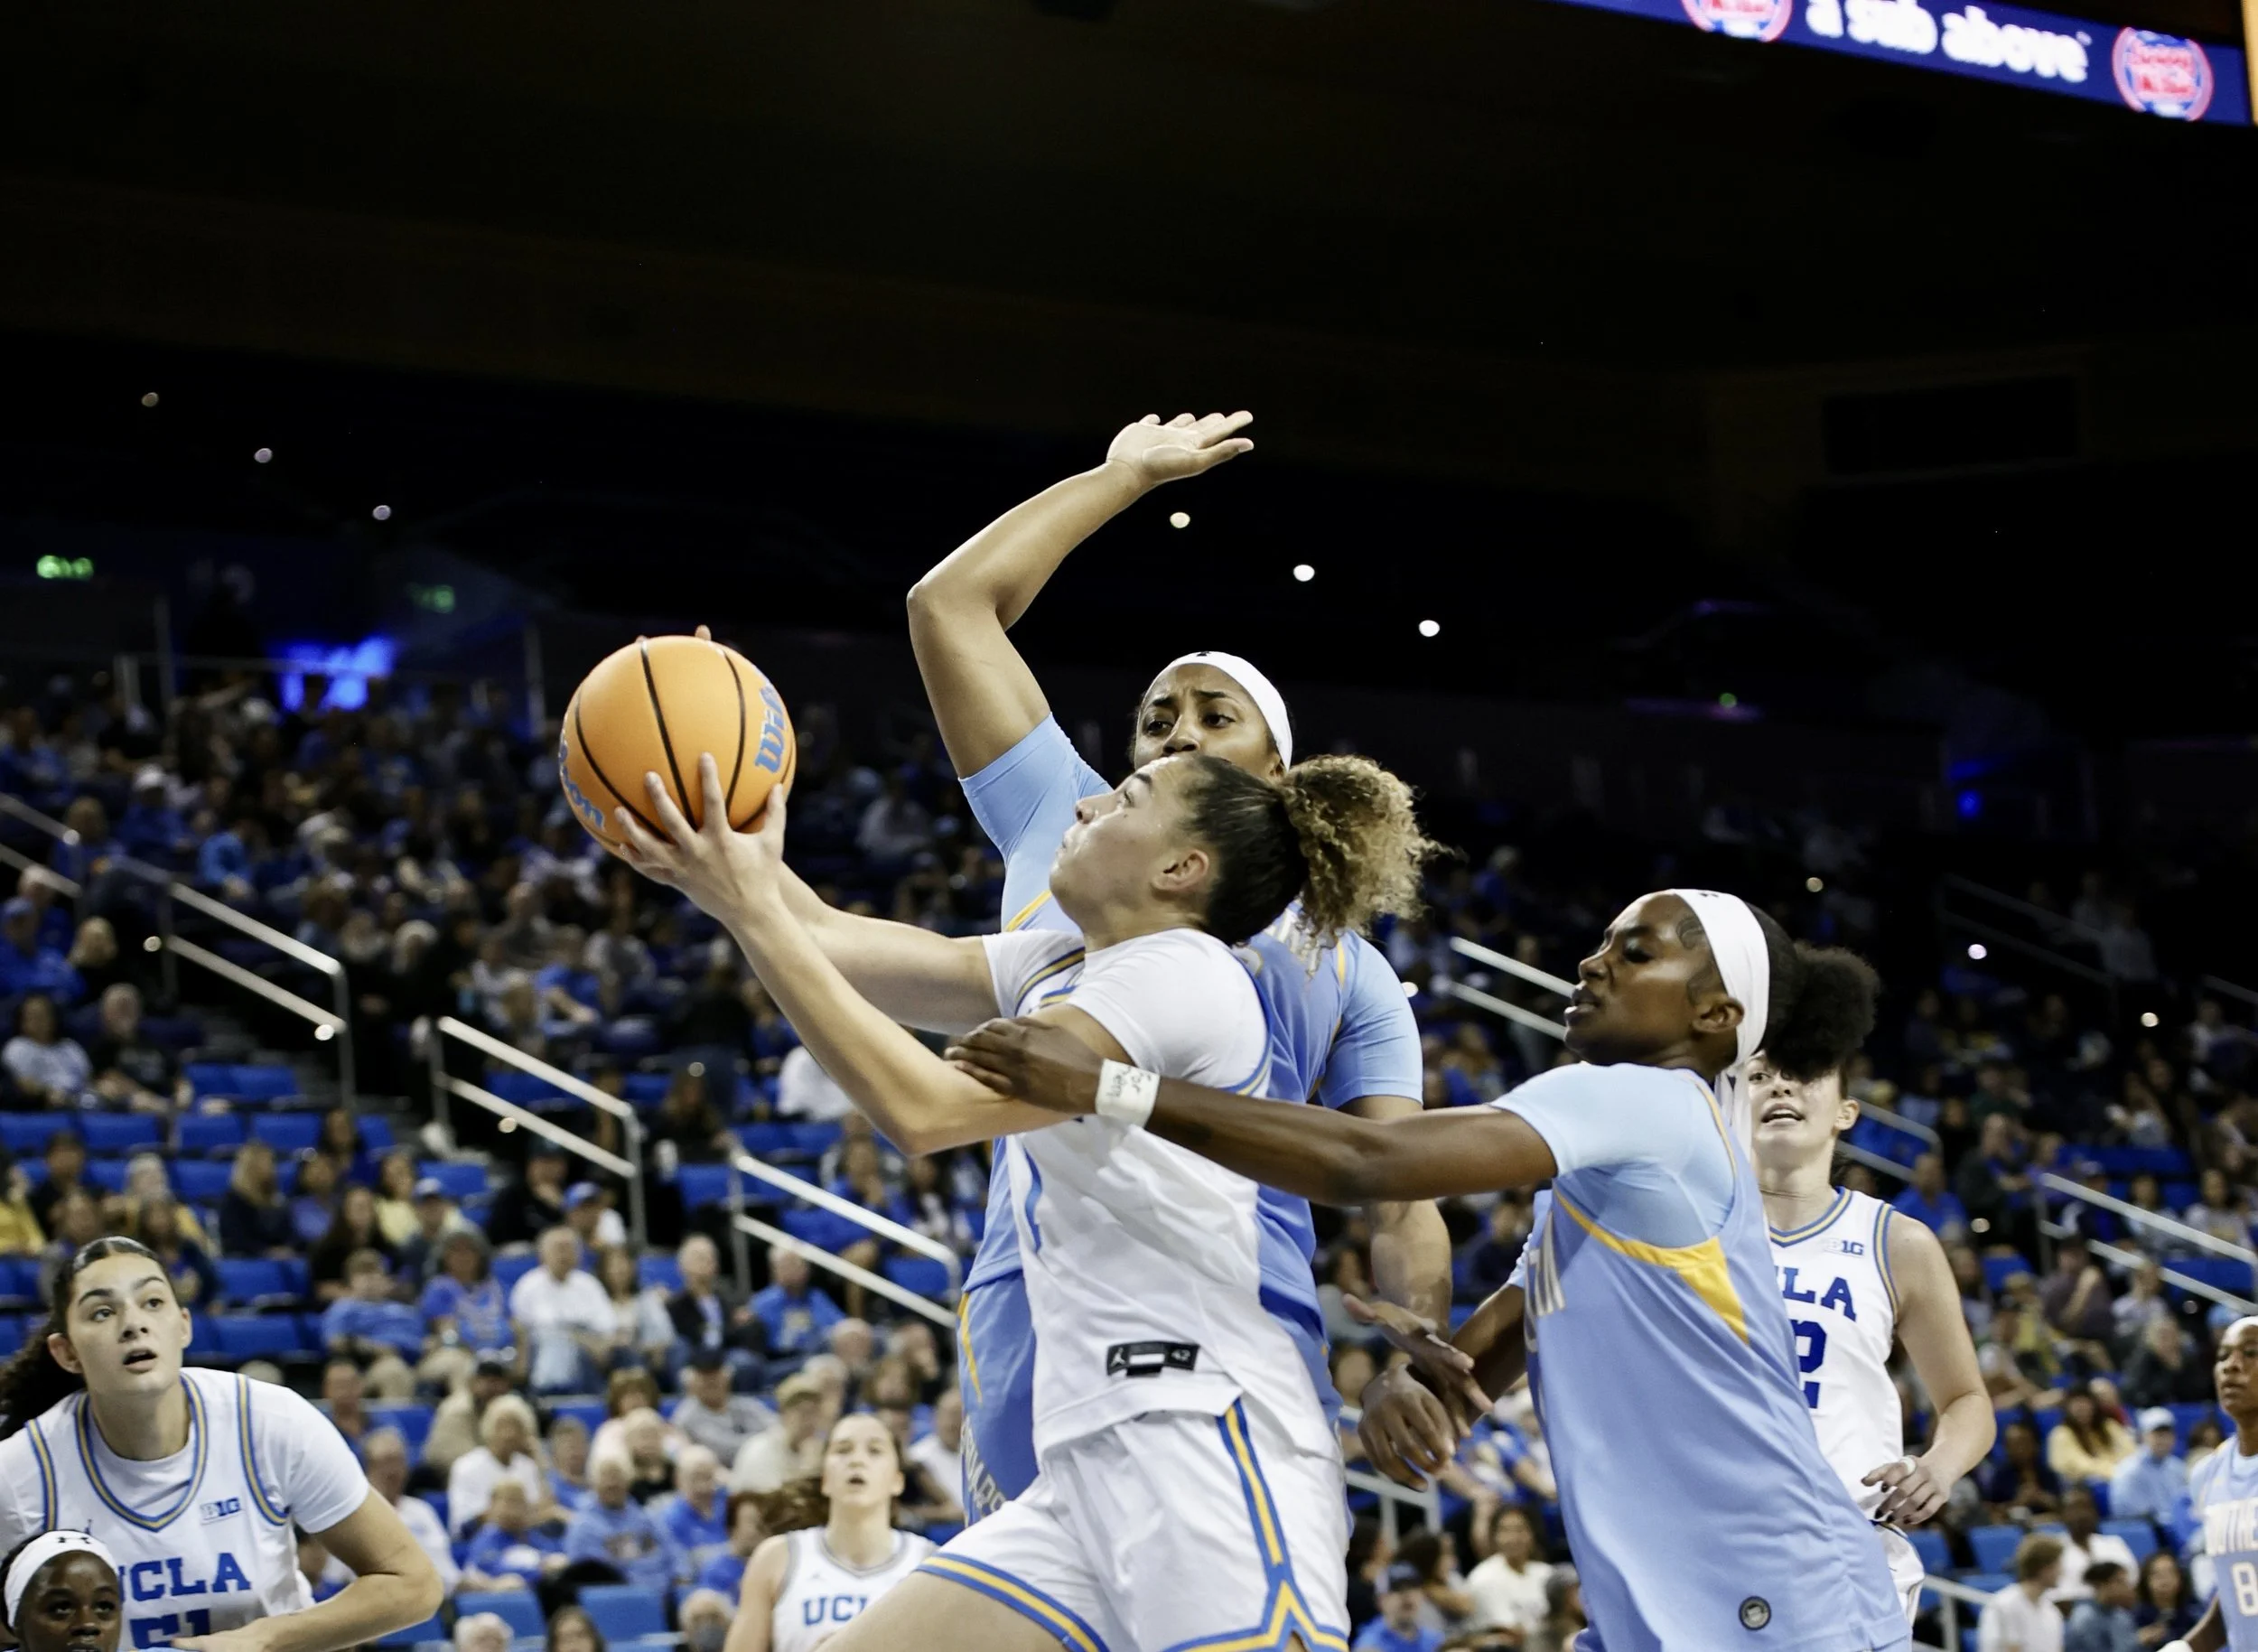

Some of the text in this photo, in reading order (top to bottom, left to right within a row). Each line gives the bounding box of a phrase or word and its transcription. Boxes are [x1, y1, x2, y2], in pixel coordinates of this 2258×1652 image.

[1942, 5, 2088, 82] above
[754, 682, 786, 773] Wil
[1776, 1266, 1857, 1322] LA
[1789, 1319, 1827, 1409] 2
